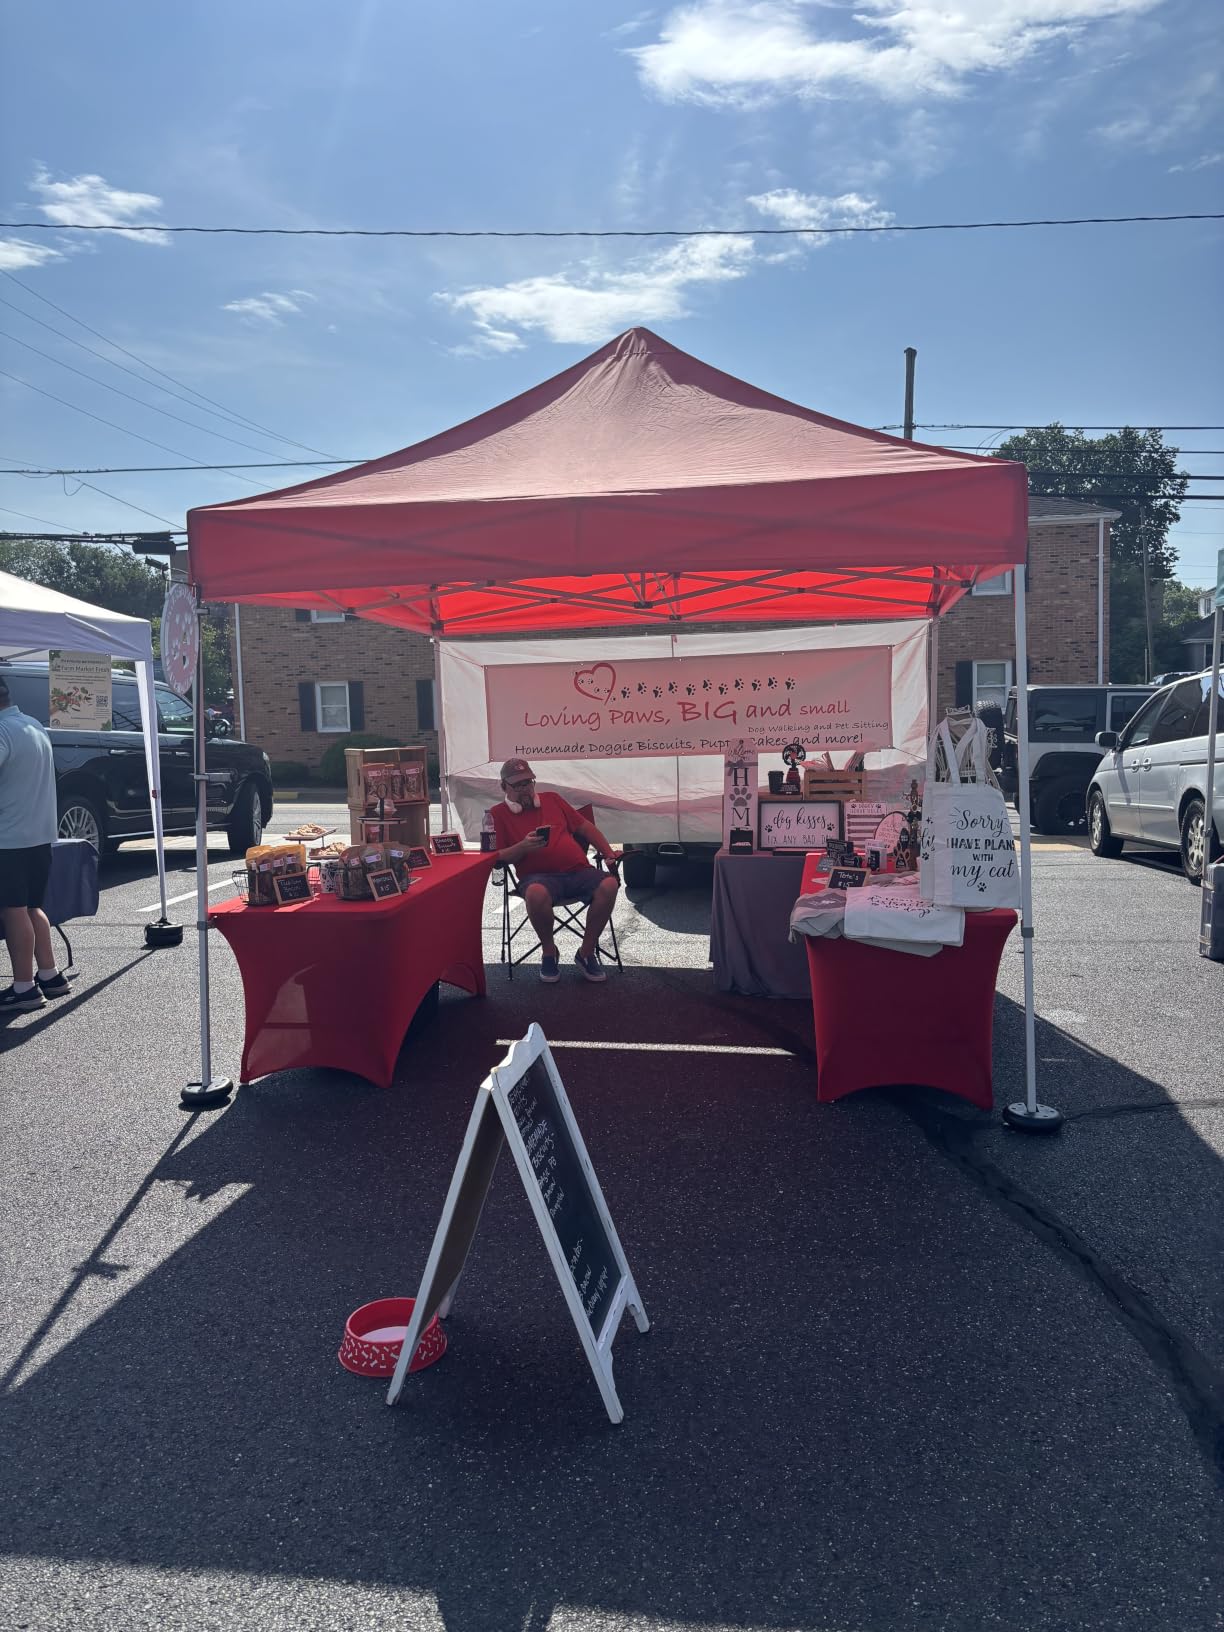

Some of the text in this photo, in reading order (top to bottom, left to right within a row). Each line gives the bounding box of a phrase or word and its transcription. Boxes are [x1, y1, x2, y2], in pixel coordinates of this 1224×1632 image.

[524, 697, 851, 732] Loving Paws, BIG and small
[748, 720, 889, 735] Dog Walking and Pet Sitting
[515, 742, 585, 755] Homemade
[589, 740, 634, 756] Doggie
[636, 738, 696, 752] Biscuits,
[700, 738, 731, 753] Pup
[792, 733, 821, 746] and
[825, 732, 864, 745] more!
[773, 806, 827, 830] dog kisses
[956, 809, 1009, 838] Sorry
[783, 835, 797, 844] ANY
[802, 835, 816, 844] BAD
[946, 838, 950, 849] I
[951, 837, 981, 850] HAVE
[972, 853, 994, 862] WITH
[951, 859, 1015, 888] my cat
[525, 1119, 548, 1156] OMEMADE
